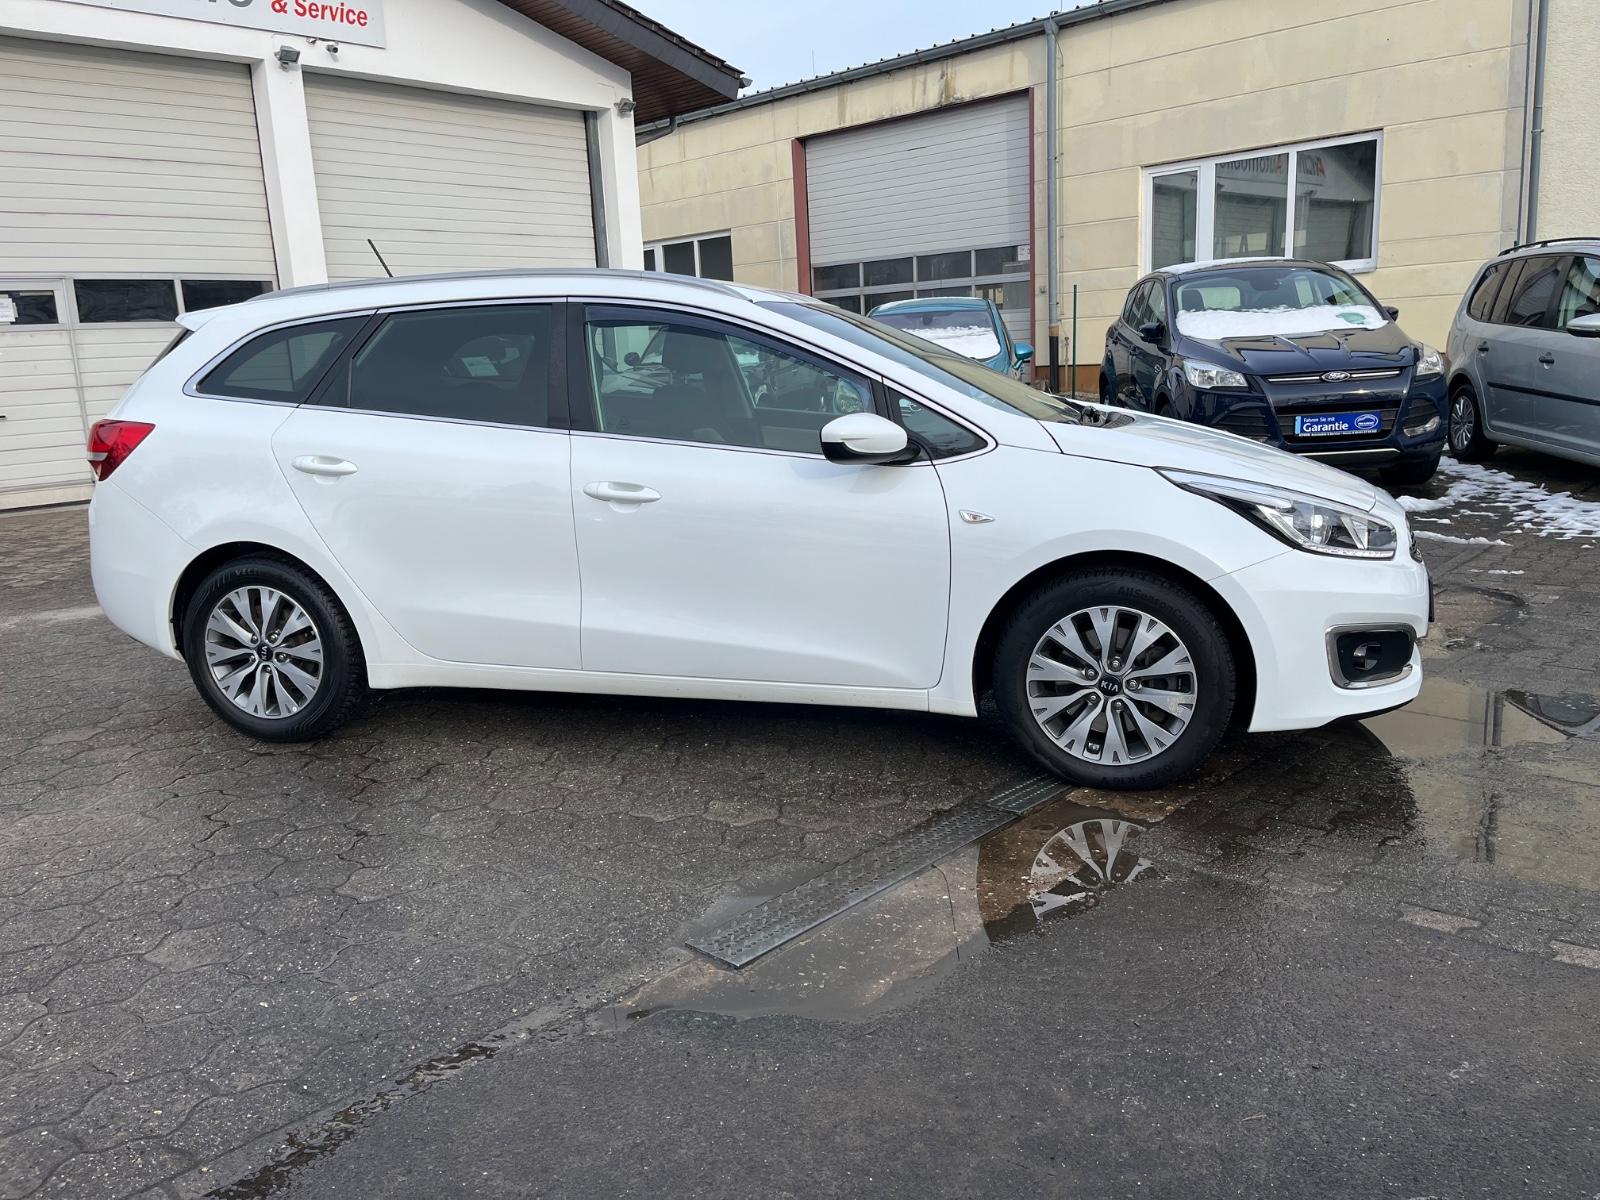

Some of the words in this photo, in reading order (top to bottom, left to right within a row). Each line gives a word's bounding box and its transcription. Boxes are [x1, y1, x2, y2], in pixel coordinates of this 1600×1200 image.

[271, 0, 287, 14] &
[294, 0, 368, 26] Service
[1303, 421, 1349, 432] Garantie
[1101, 680, 1119, 692] KIA
